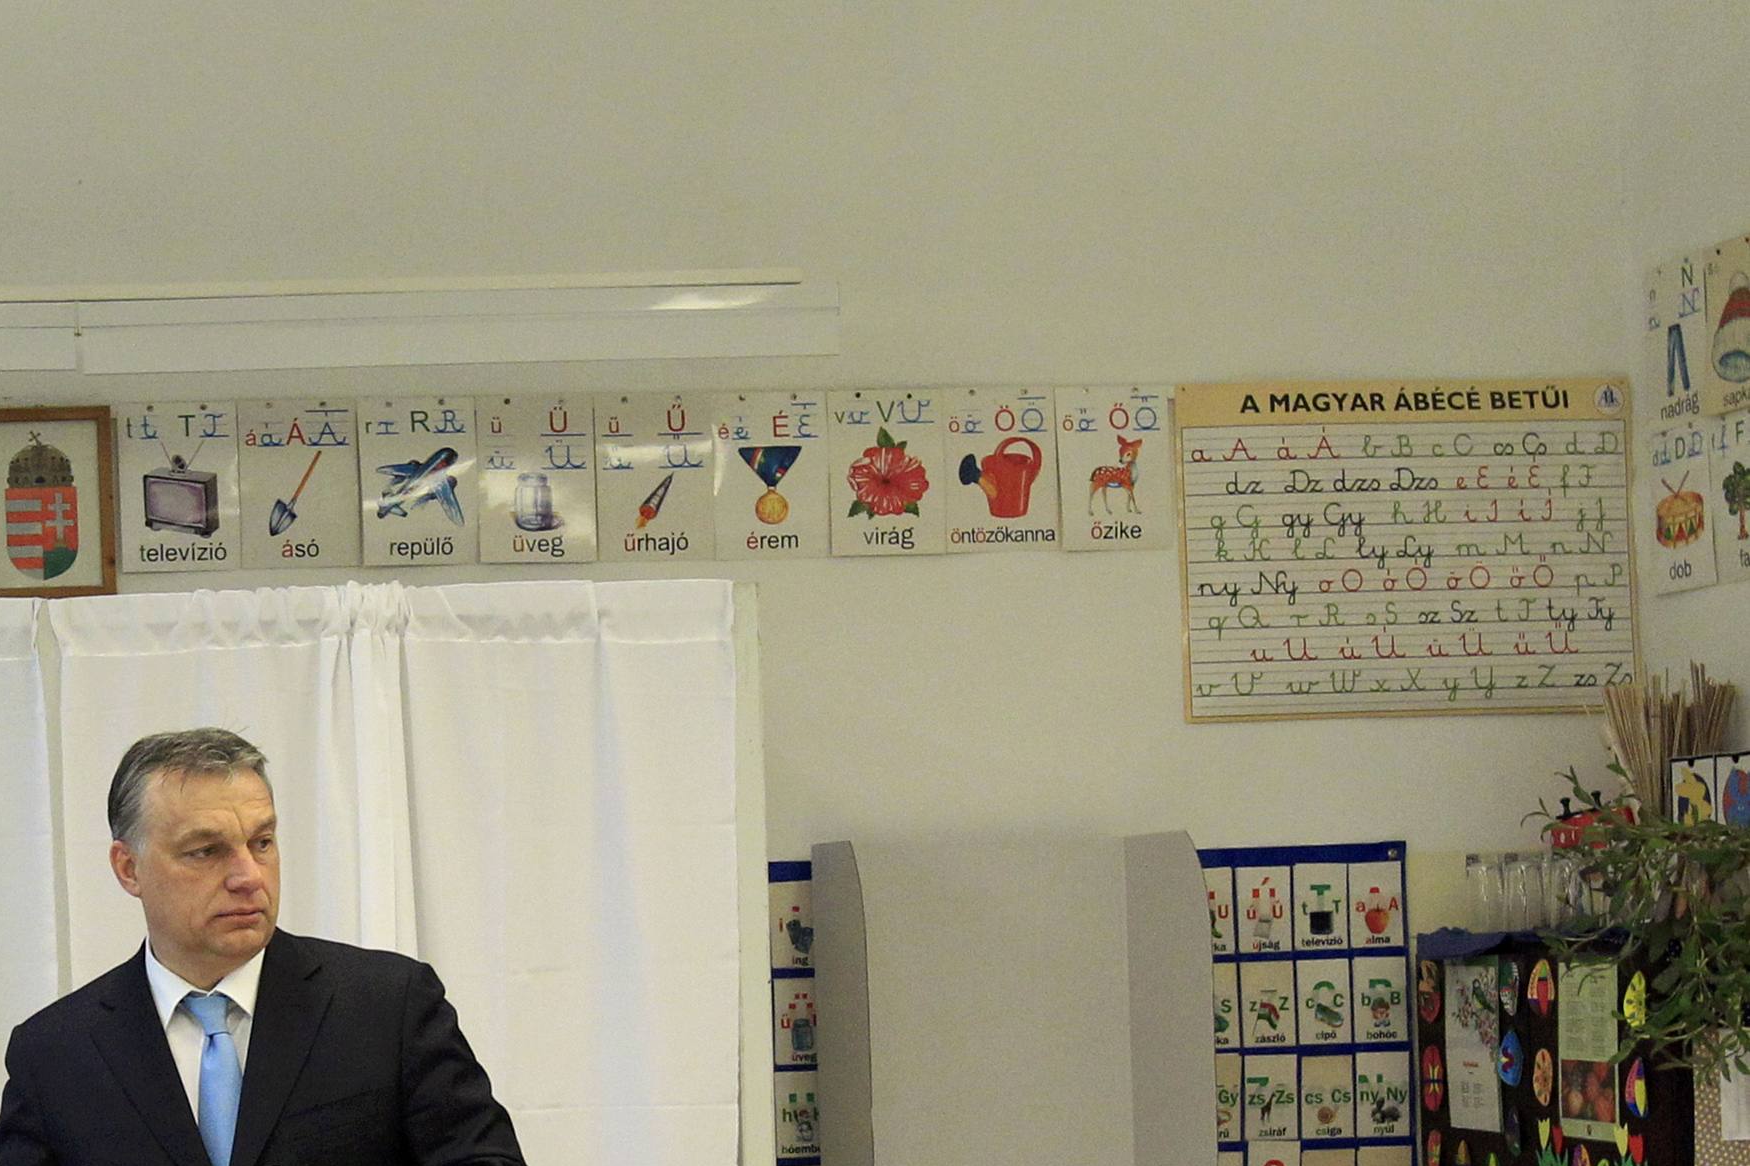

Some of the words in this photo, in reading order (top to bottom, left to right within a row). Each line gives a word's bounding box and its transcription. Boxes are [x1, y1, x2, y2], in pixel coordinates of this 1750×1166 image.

[1240, 394, 1260, 413] A
[1270, 392, 1385, 412] MAGYAR
[1394, 386, 1481, 410] ÁBÉCÉ
[1490, 385, 1569, 409] BETŰI
[1660, 392, 1700, 420] nadrág
[1722, 386, 1750, 407] sapk
[746, 531, 799, 550] érem
[863, 526, 915, 549] virág
[950, 526, 1056, 543] öntözőkanna
[1091, 521, 1142, 540] őzike
[140, 543, 227, 562] televízió
[281, 539, 320, 558] ásó
[389, 536, 454, 560] repülő
[512, 534, 564, 557] üveg
[624, 531, 689, 555] űrhajó
[1669, 560, 1692, 580] dob
[1365, 935, 1390, 945] alma
[1316, 1127, 1342, 1136] csiga
